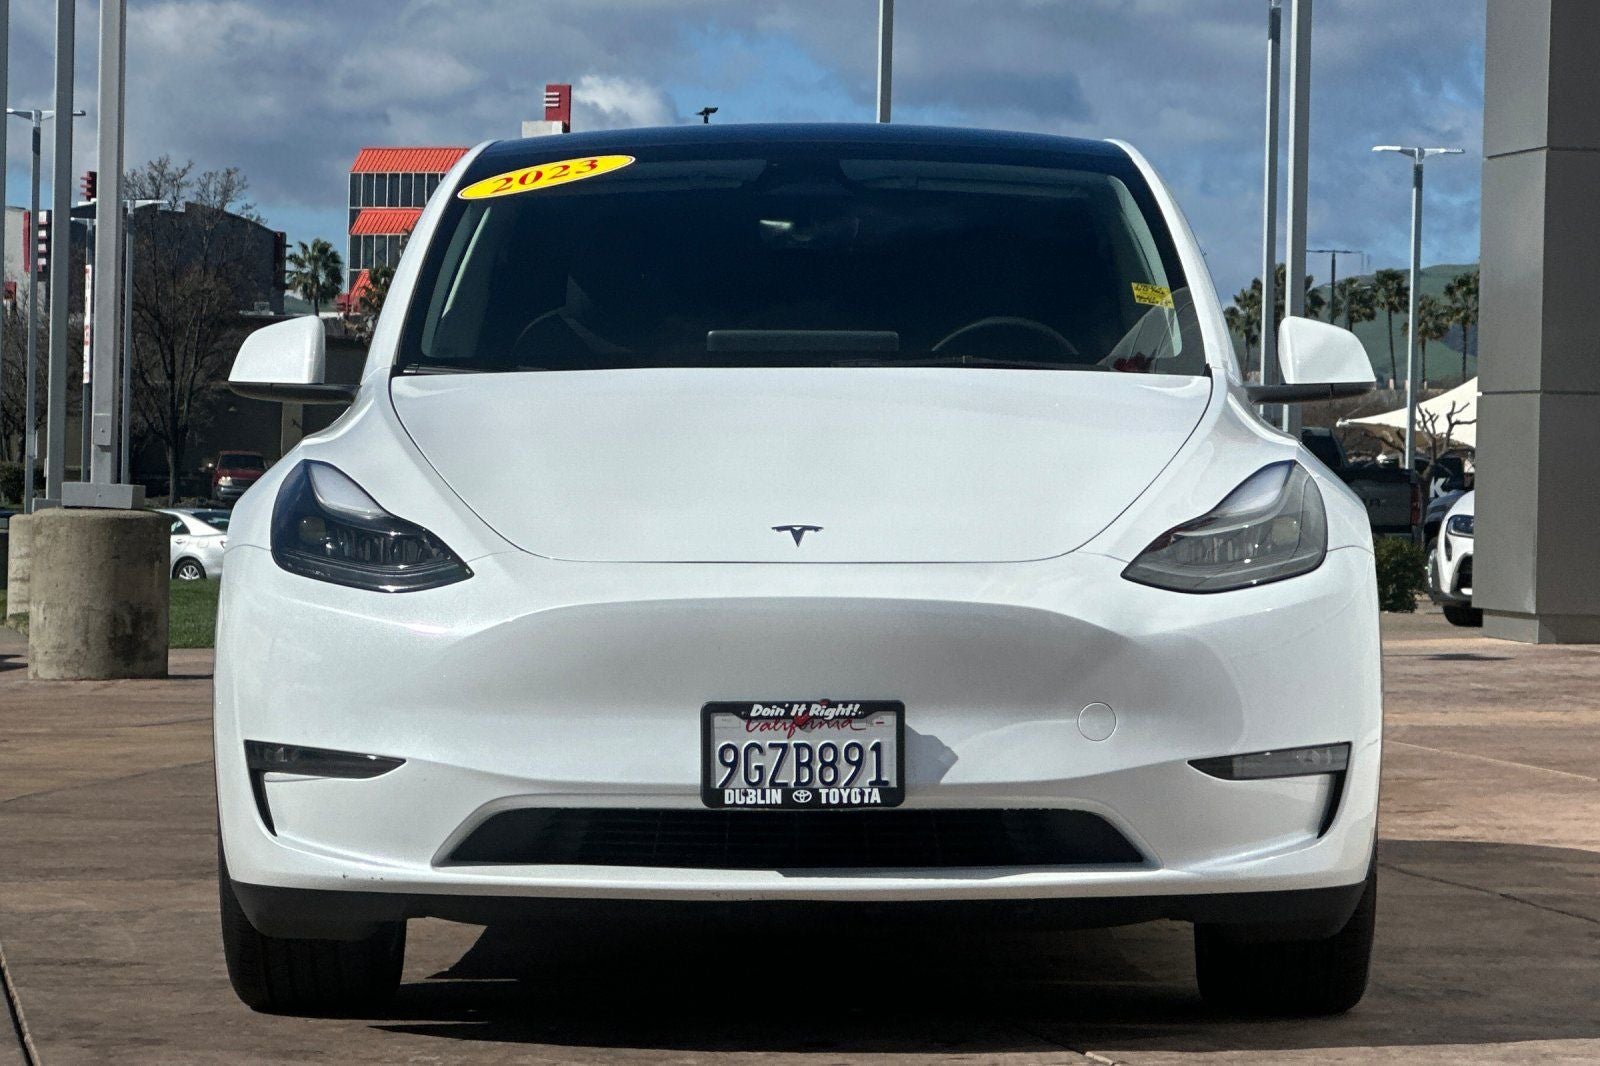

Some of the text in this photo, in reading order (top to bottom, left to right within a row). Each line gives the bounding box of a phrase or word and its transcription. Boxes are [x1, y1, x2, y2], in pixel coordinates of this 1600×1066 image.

[491, 159, 598, 194] 2023
[750, 704, 790, 717] Doin'
[795, 704, 807, 716] It
[718, 740, 890, 788] 9GZB891
[724, 789, 881, 804] DUBLIN TOYOTA
